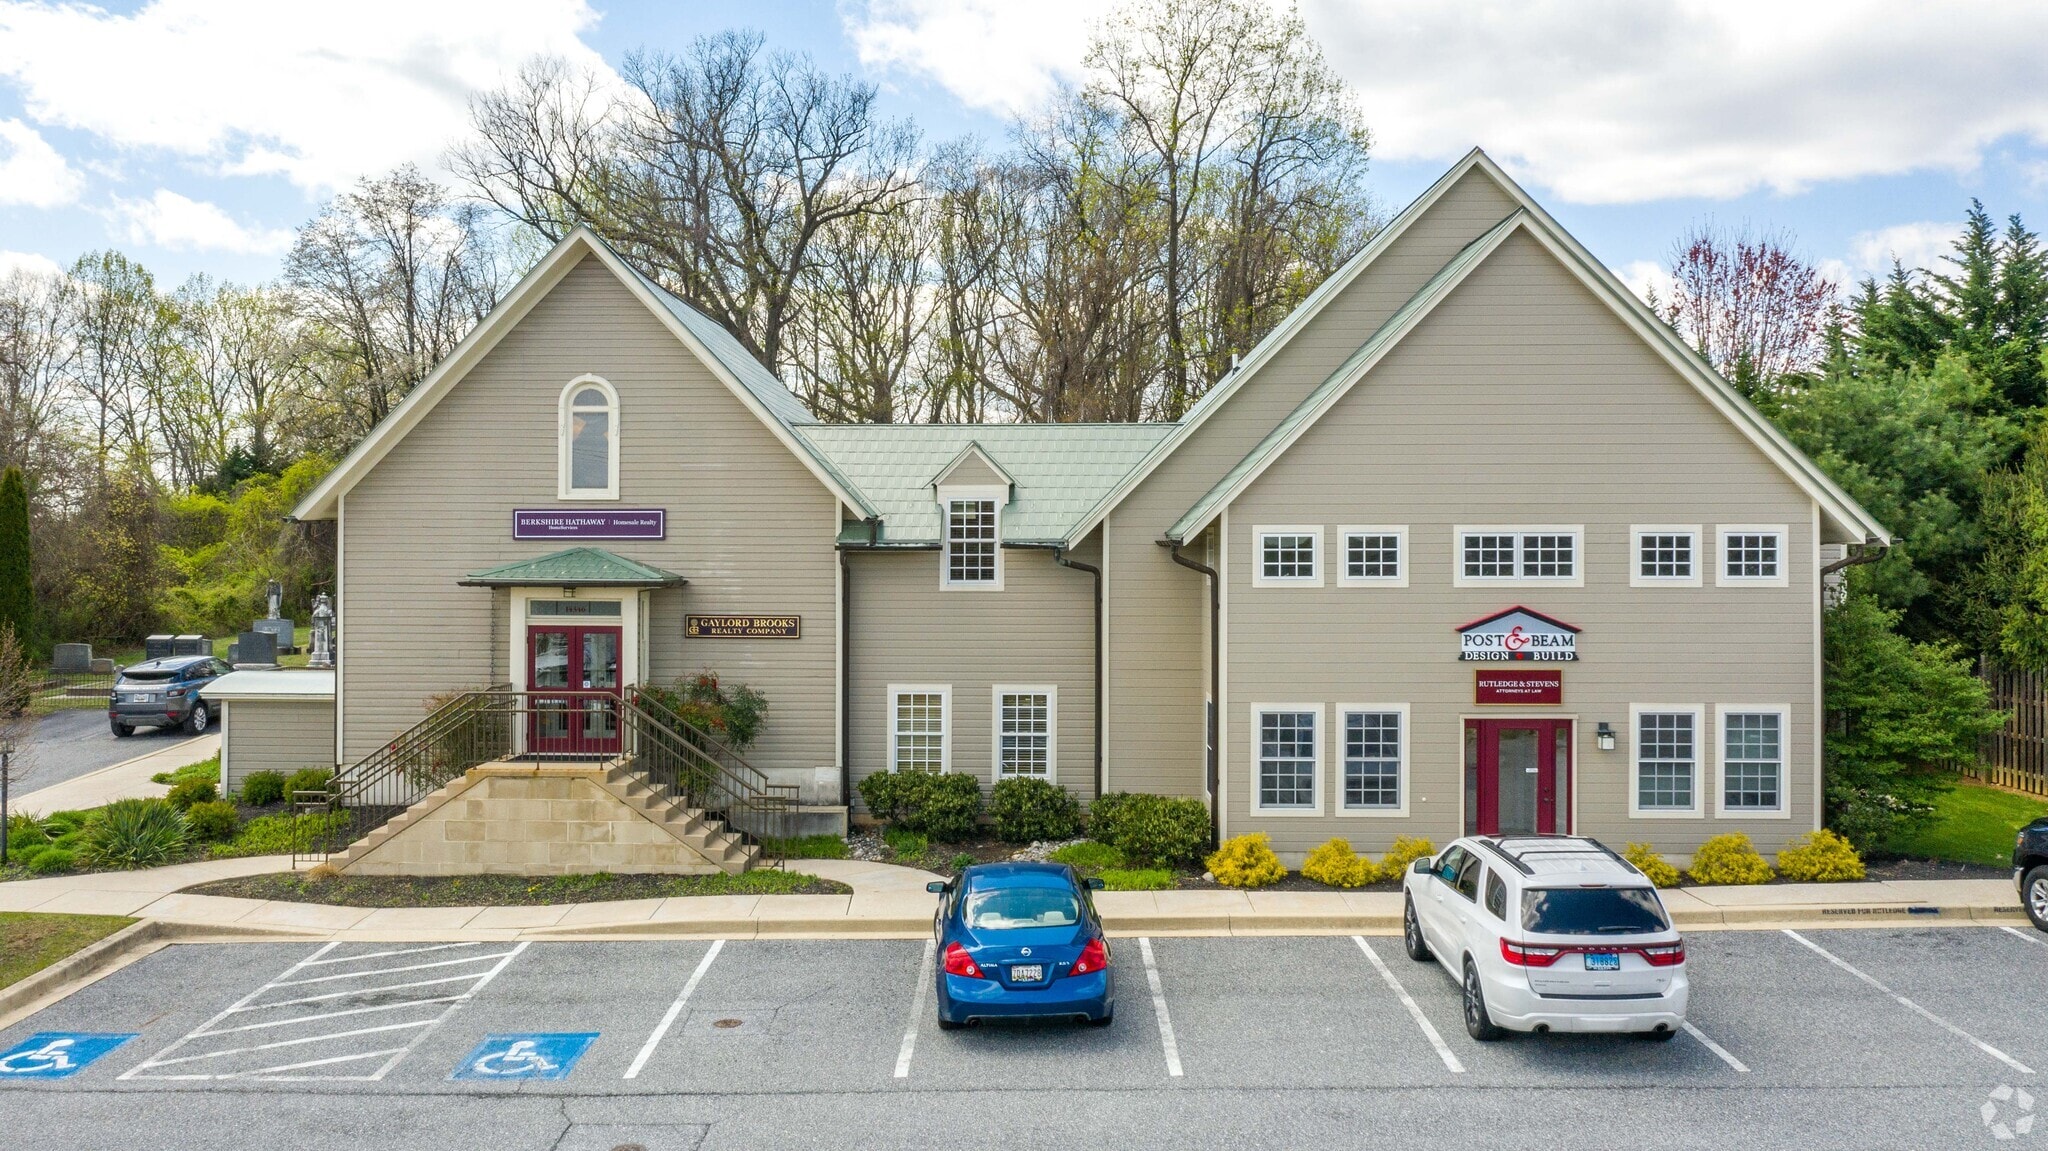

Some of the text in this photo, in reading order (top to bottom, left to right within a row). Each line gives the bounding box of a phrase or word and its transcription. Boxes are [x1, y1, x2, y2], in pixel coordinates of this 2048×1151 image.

[640, 519, 657, 527] Realty
[700, 619, 795, 627] GAYLORD BROOKS
[1463, 626, 1574, 651] POST & BEAM
[1464, 651, 1574, 660] DESIGN BUILD
